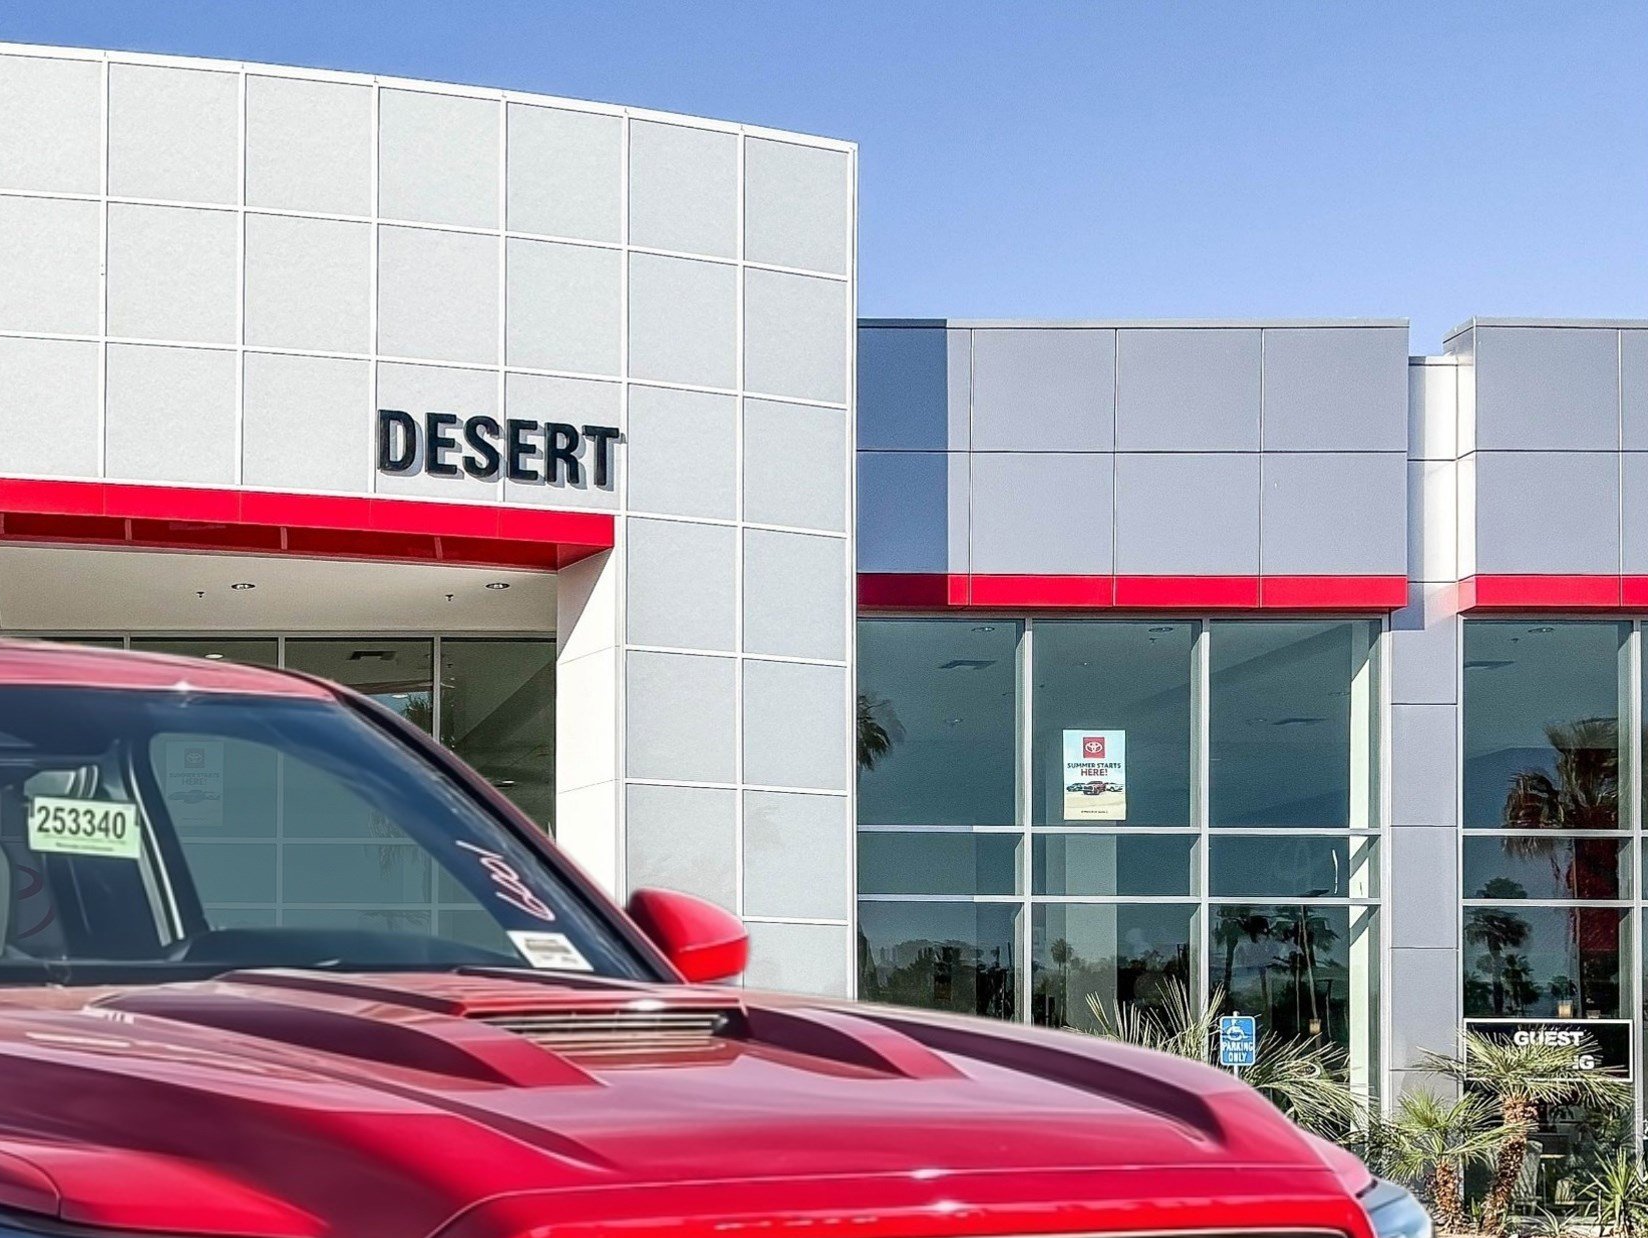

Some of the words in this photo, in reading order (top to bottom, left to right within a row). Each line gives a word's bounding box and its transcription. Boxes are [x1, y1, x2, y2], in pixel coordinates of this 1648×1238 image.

[377, 409, 620, 488] DESERT
[1080, 768, 1108, 776] HERE!
[36, 805, 126, 840] 253340
[1513, 1030, 1584, 1047] GUEST
[1222, 1041, 1254, 1052] PARKING
[1228, 1052, 1247, 1062] ONLY
